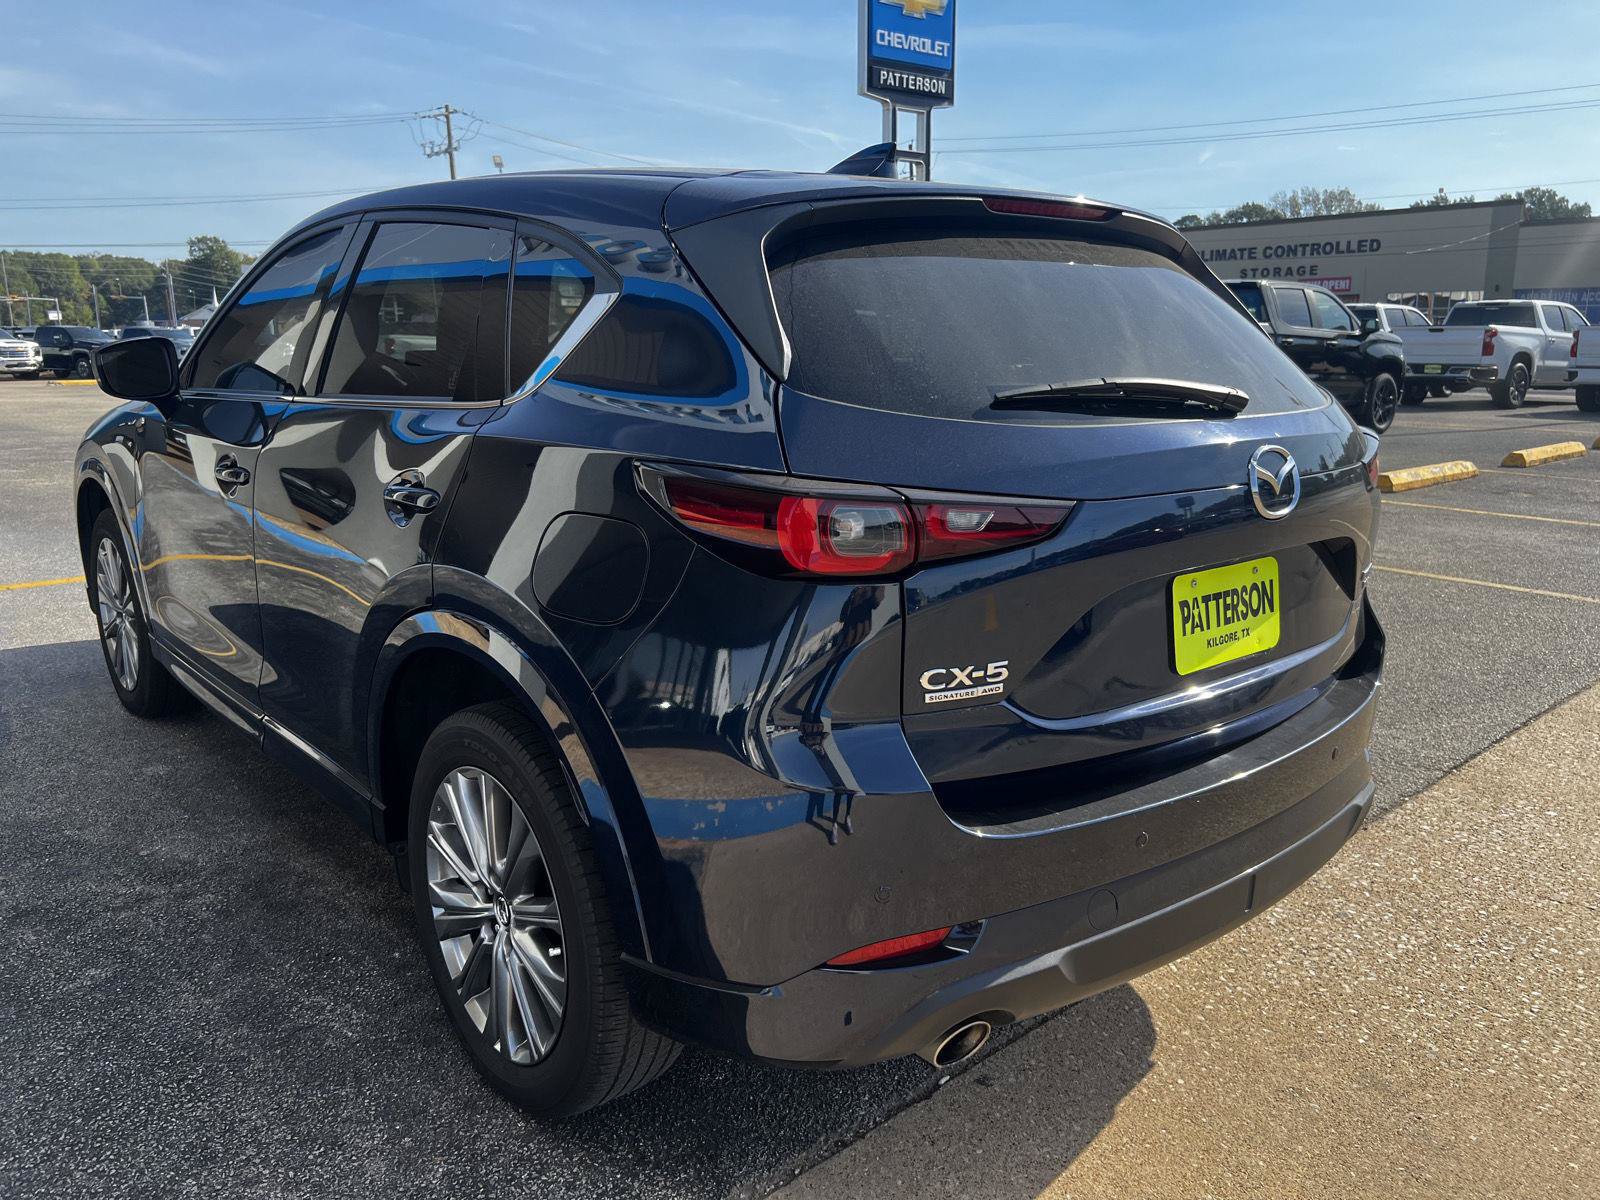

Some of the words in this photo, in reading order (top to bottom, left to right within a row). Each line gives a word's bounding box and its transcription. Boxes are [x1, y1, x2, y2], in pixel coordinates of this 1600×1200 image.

[876, 29, 950, 56] CHEVROLET
[880, 70, 945, 94] PATTERSON
[1198, 247, 1257, 262] LIMATE
[1262, 238, 1381, 259] CONTROLLED
[1240, 265, 1319, 279] STORAGE
[1179, 579, 1275, 637] PATTERSON
[1206, 631, 1240, 649] KILGORE,
[1241, 627, 1251, 637] TX
[920, 660, 1009, 690] CX-5
[928, 690, 975, 702] SIGNATURE
[981, 686, 1001, 695] AWD
